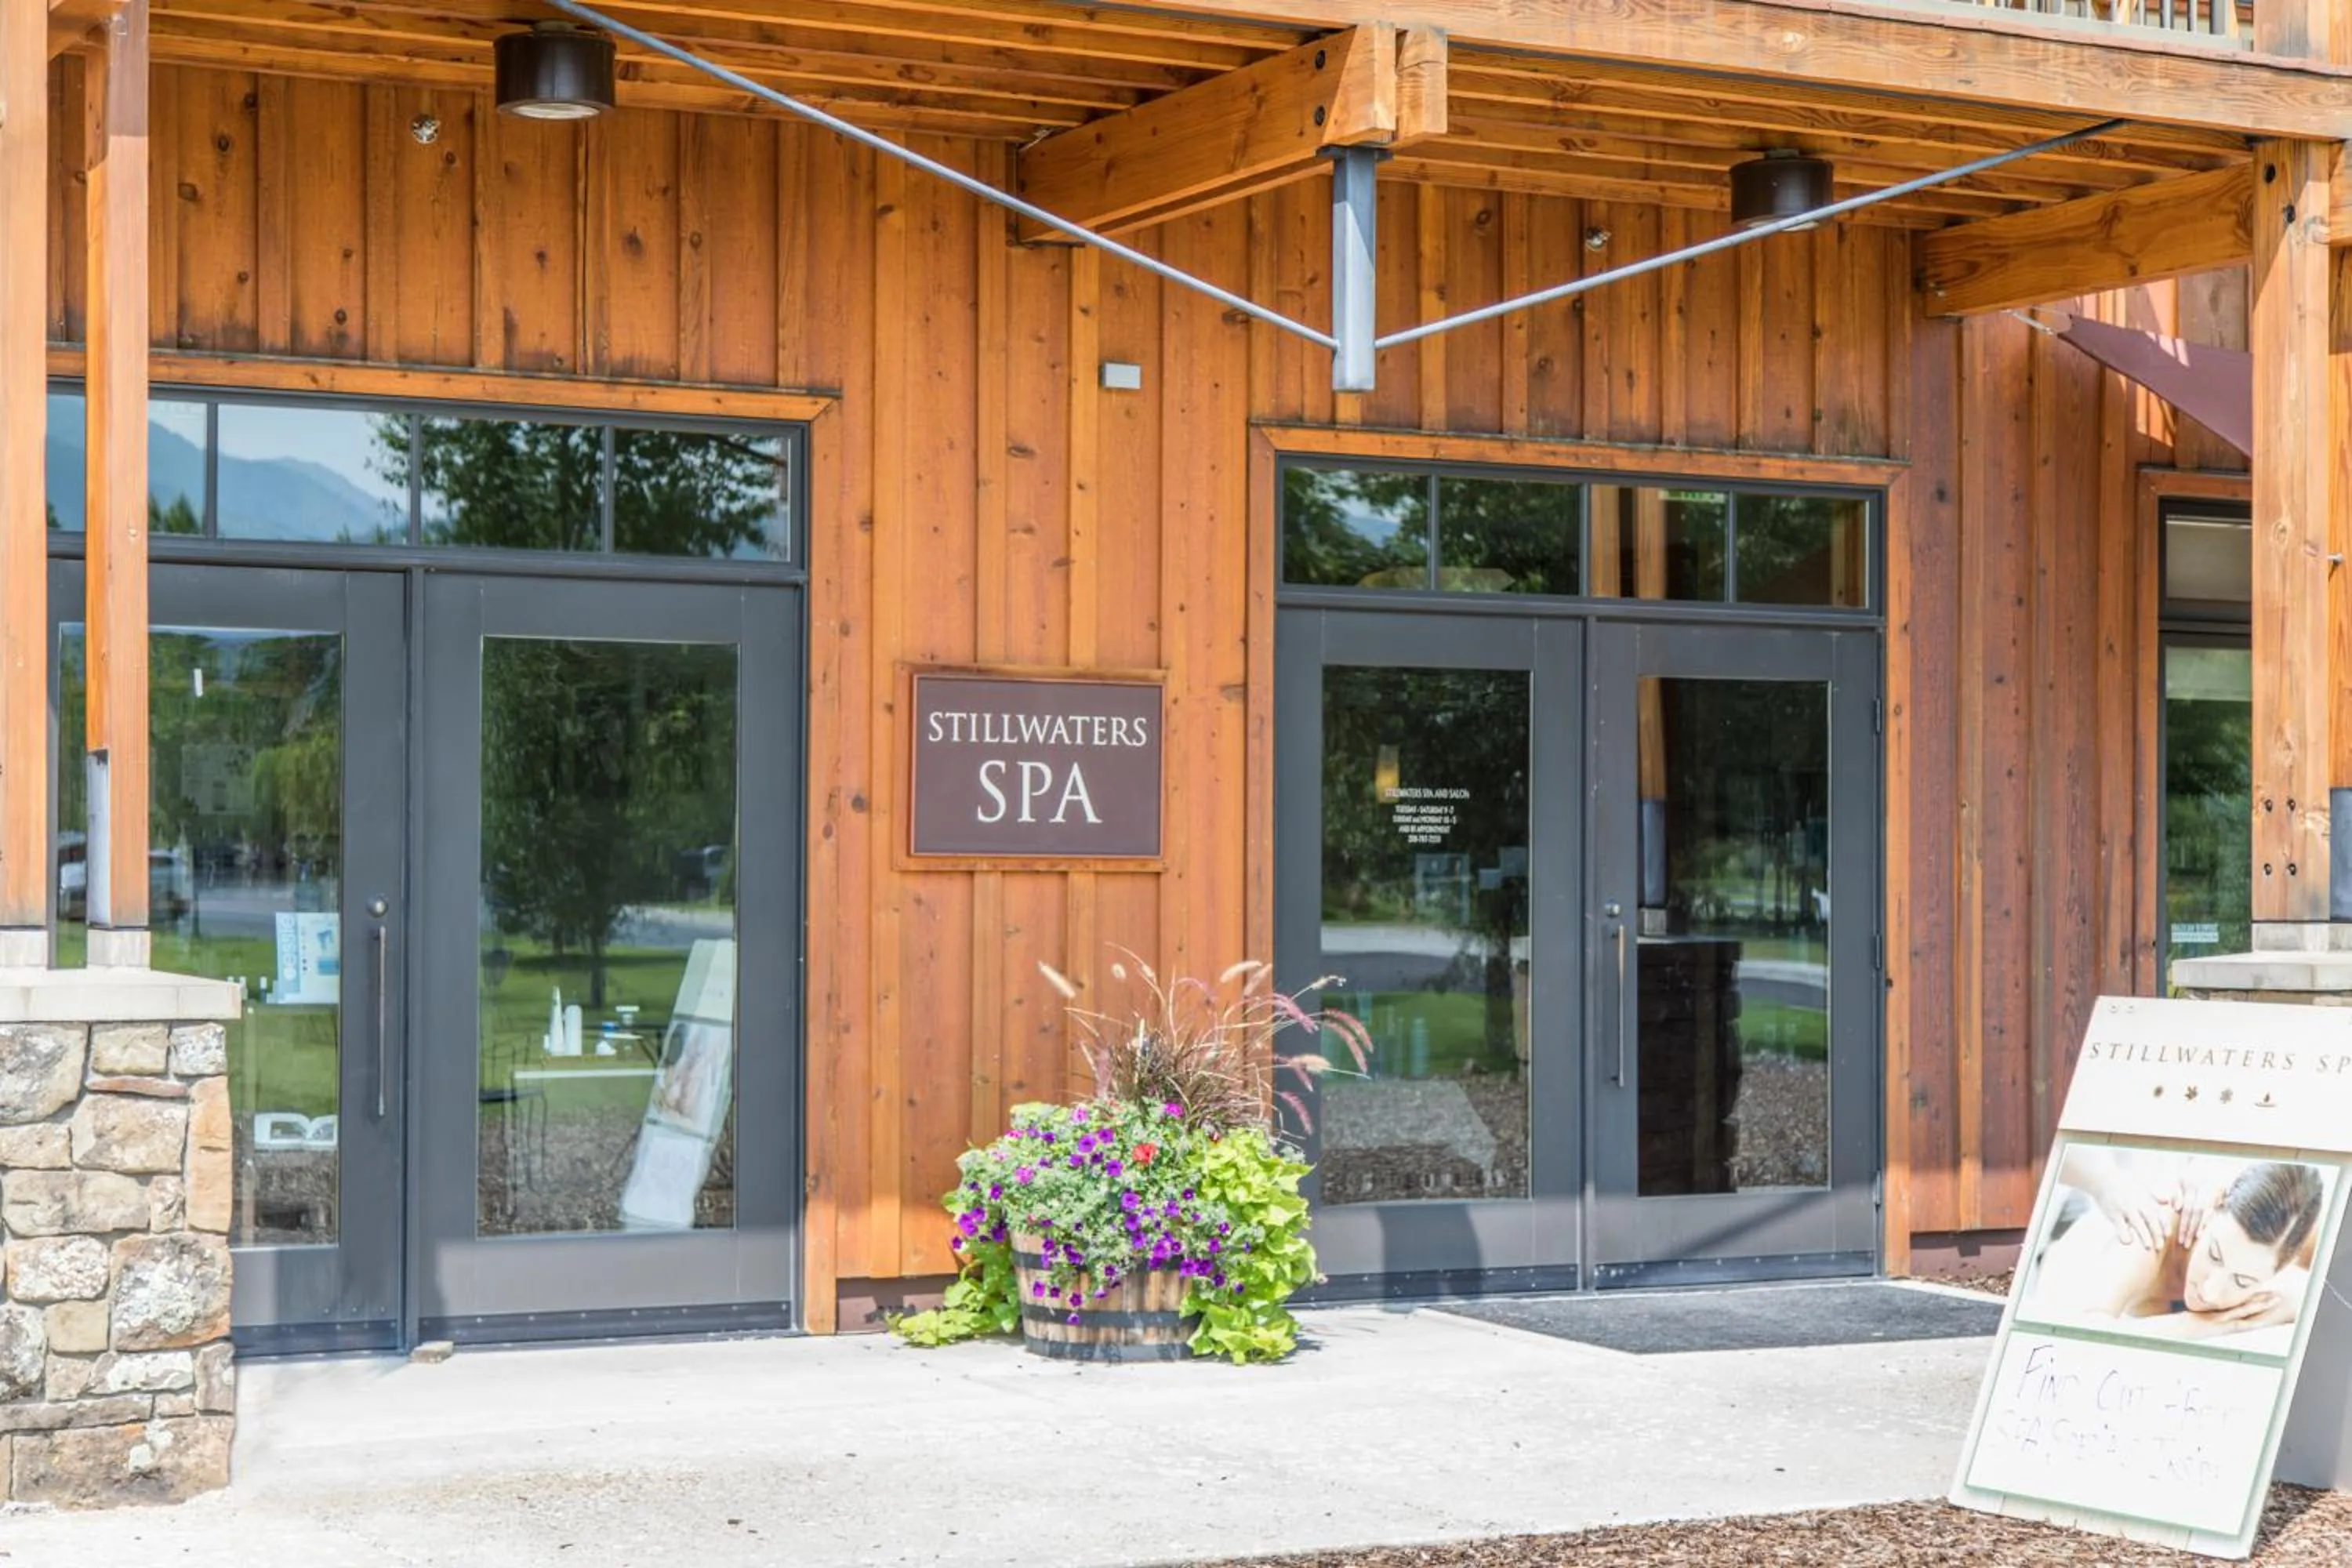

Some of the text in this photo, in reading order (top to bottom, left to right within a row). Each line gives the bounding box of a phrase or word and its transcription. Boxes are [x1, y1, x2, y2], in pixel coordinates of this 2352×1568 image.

[928, 712, 1147, 746] STILLWATERS
[978, 760, 1103, 823] SPA
[2089, 1042, 2296, 1071] STILLWATERS
